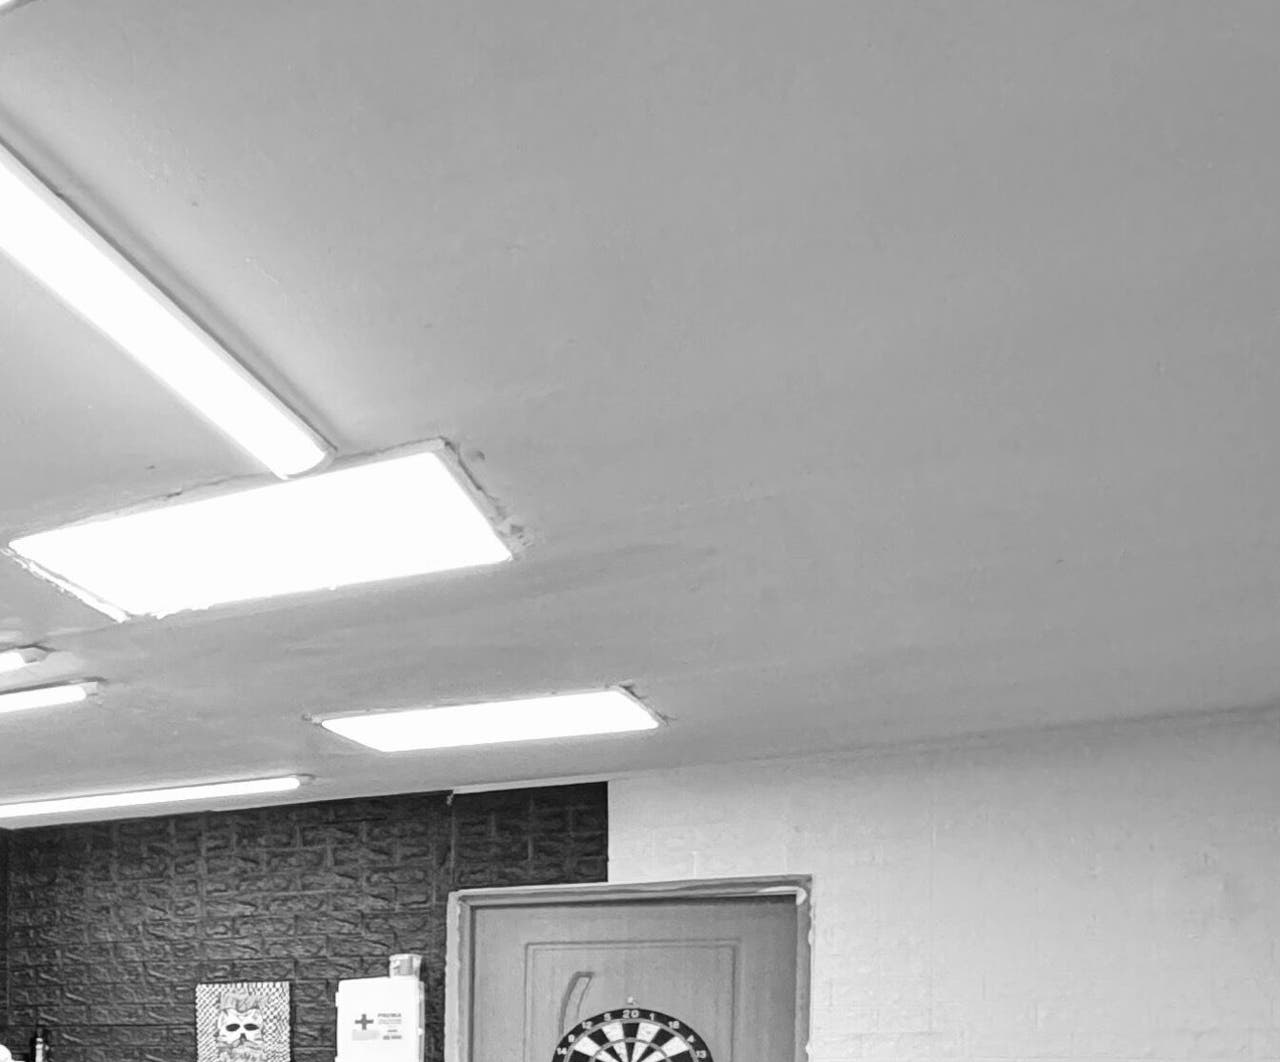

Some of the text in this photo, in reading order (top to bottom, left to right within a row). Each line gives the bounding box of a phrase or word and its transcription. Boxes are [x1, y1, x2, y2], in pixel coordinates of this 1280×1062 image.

[622, 1009, 640, 1019] 20
[650, 1013, 656, 1021] 1
[696, 1050, 707, 1059] 13
